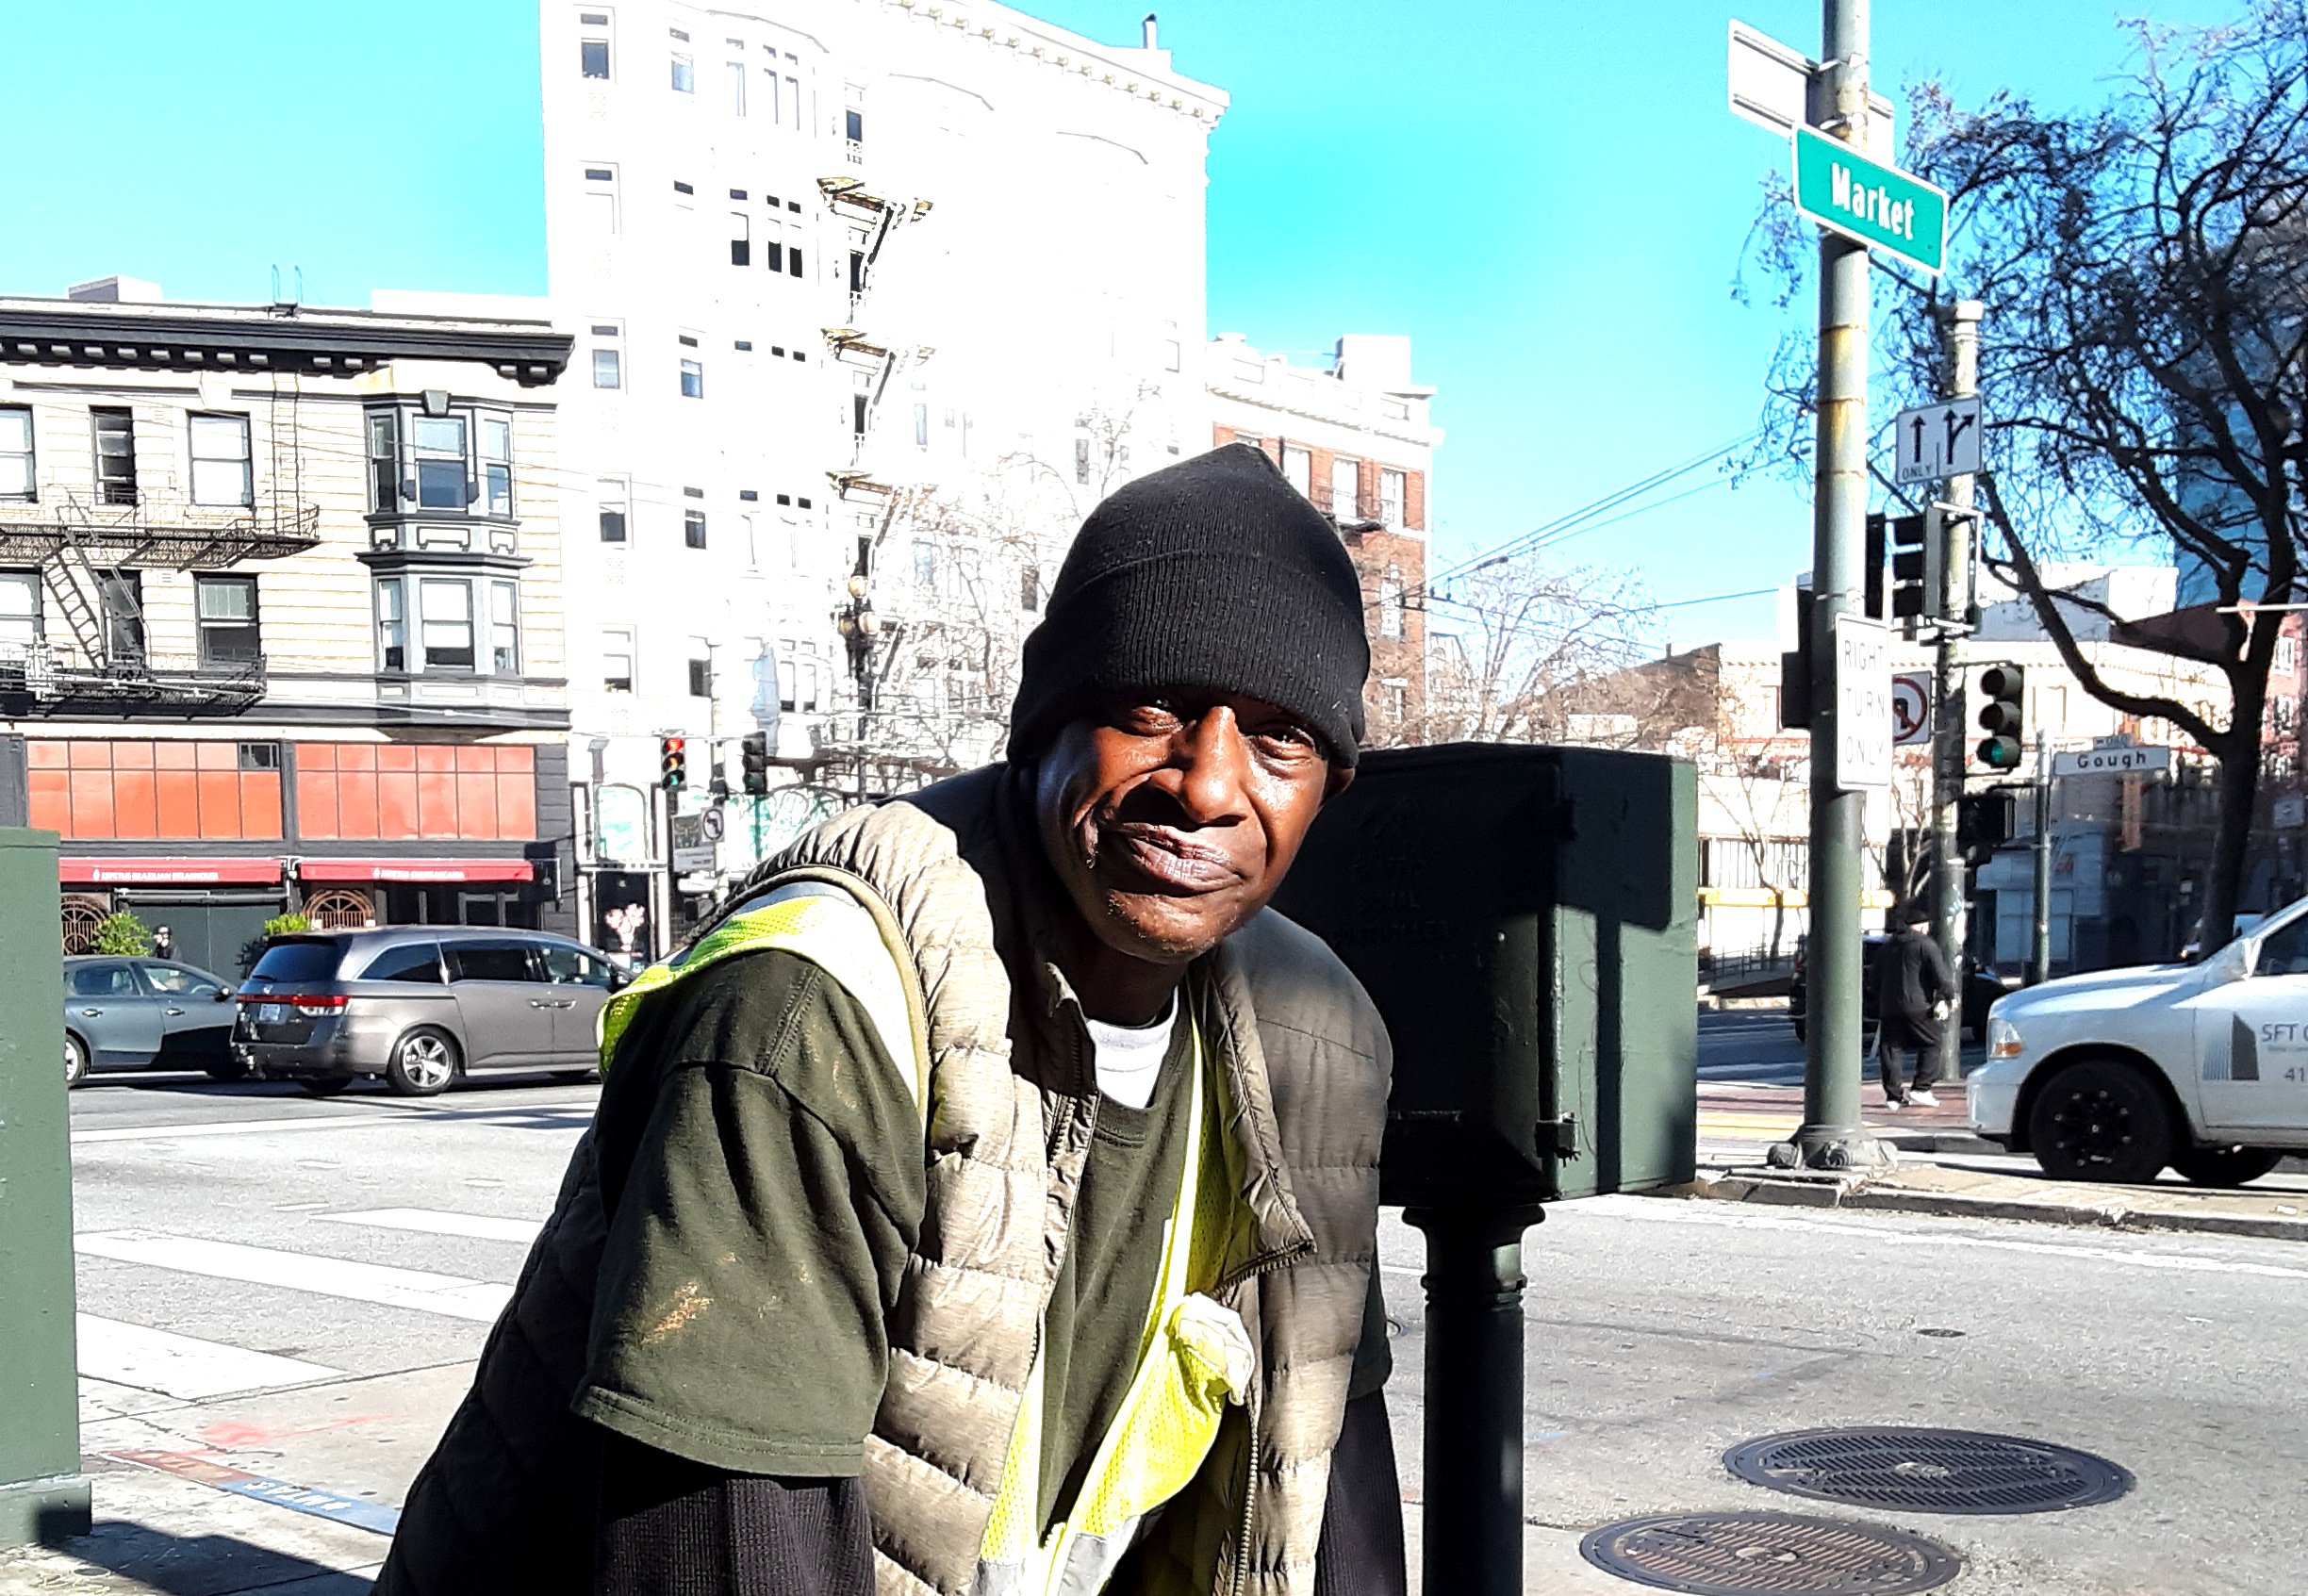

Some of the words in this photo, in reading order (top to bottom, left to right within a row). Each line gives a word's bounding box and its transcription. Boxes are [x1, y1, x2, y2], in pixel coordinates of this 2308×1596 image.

[1831, 162, 1914, 240] Market
[1902, 464, 1932, 480] ONLY
[1844, 639, 1884, 670] RIGHT
[1845, 687, 1885, 718] TURN
[1845, 735, 1884, 765] ONLY
[2077, 751, 2147, 768] Gough
[2262, 1023, 2299, 1043] SFT
